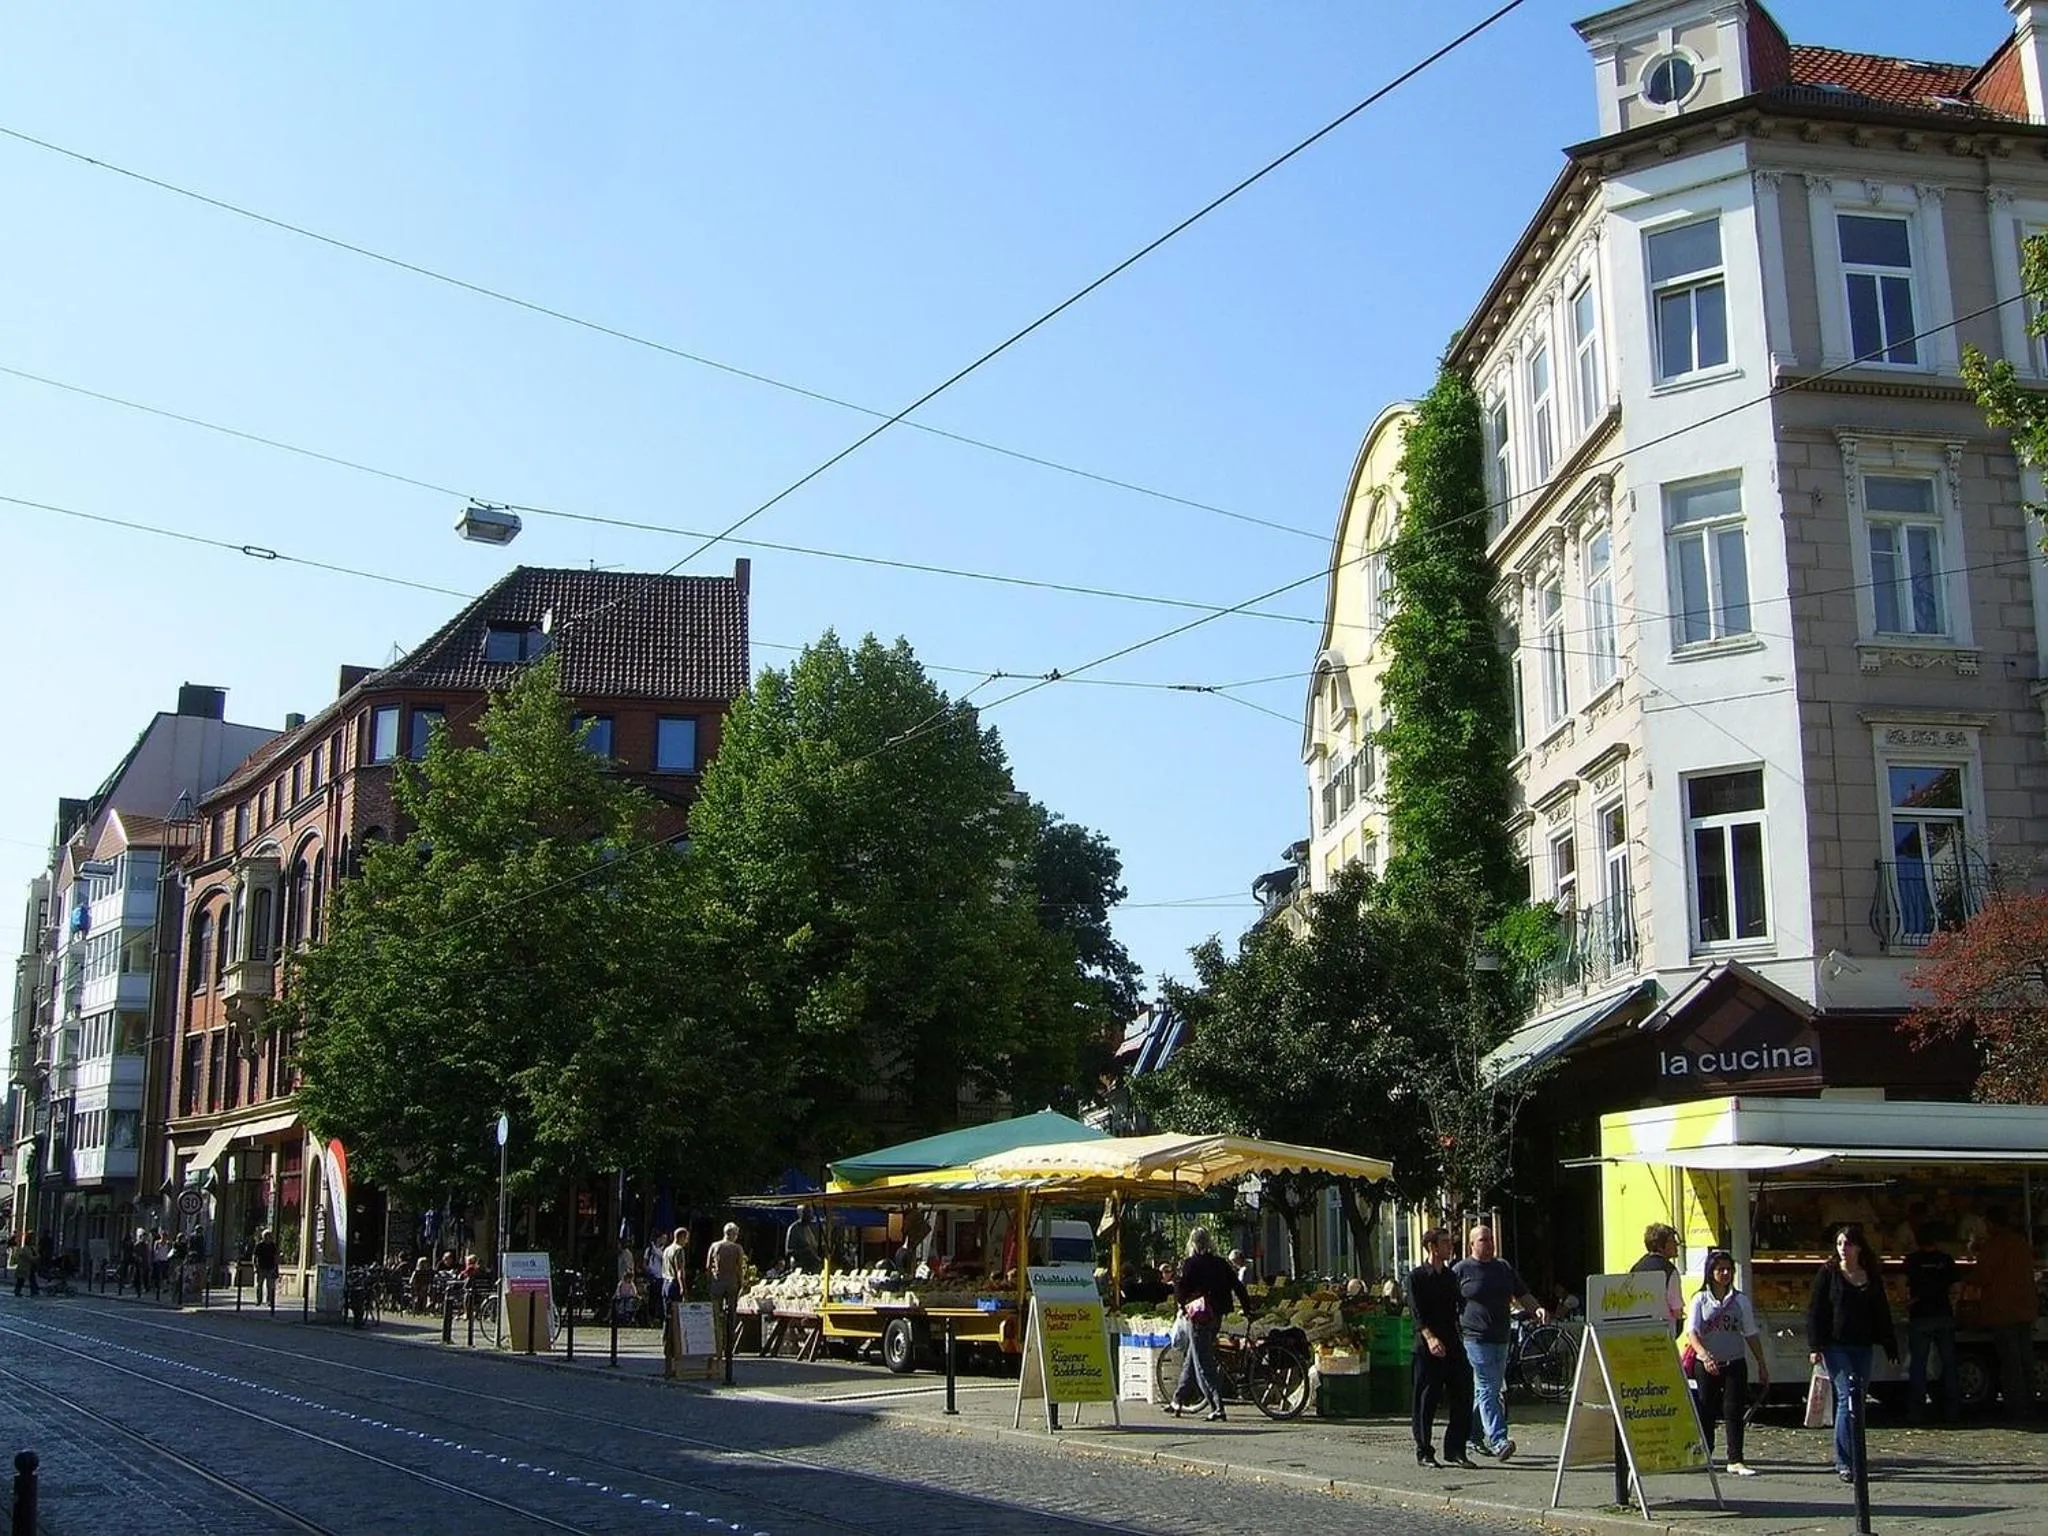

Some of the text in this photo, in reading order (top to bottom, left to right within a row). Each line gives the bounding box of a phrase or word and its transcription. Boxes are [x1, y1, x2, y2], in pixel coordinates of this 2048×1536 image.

[1660, 1043, 1813, 1075] la cucina
[184, 1197, 199, 1209] 30
[1620, 1381, 1671, 1403] Engadiner
